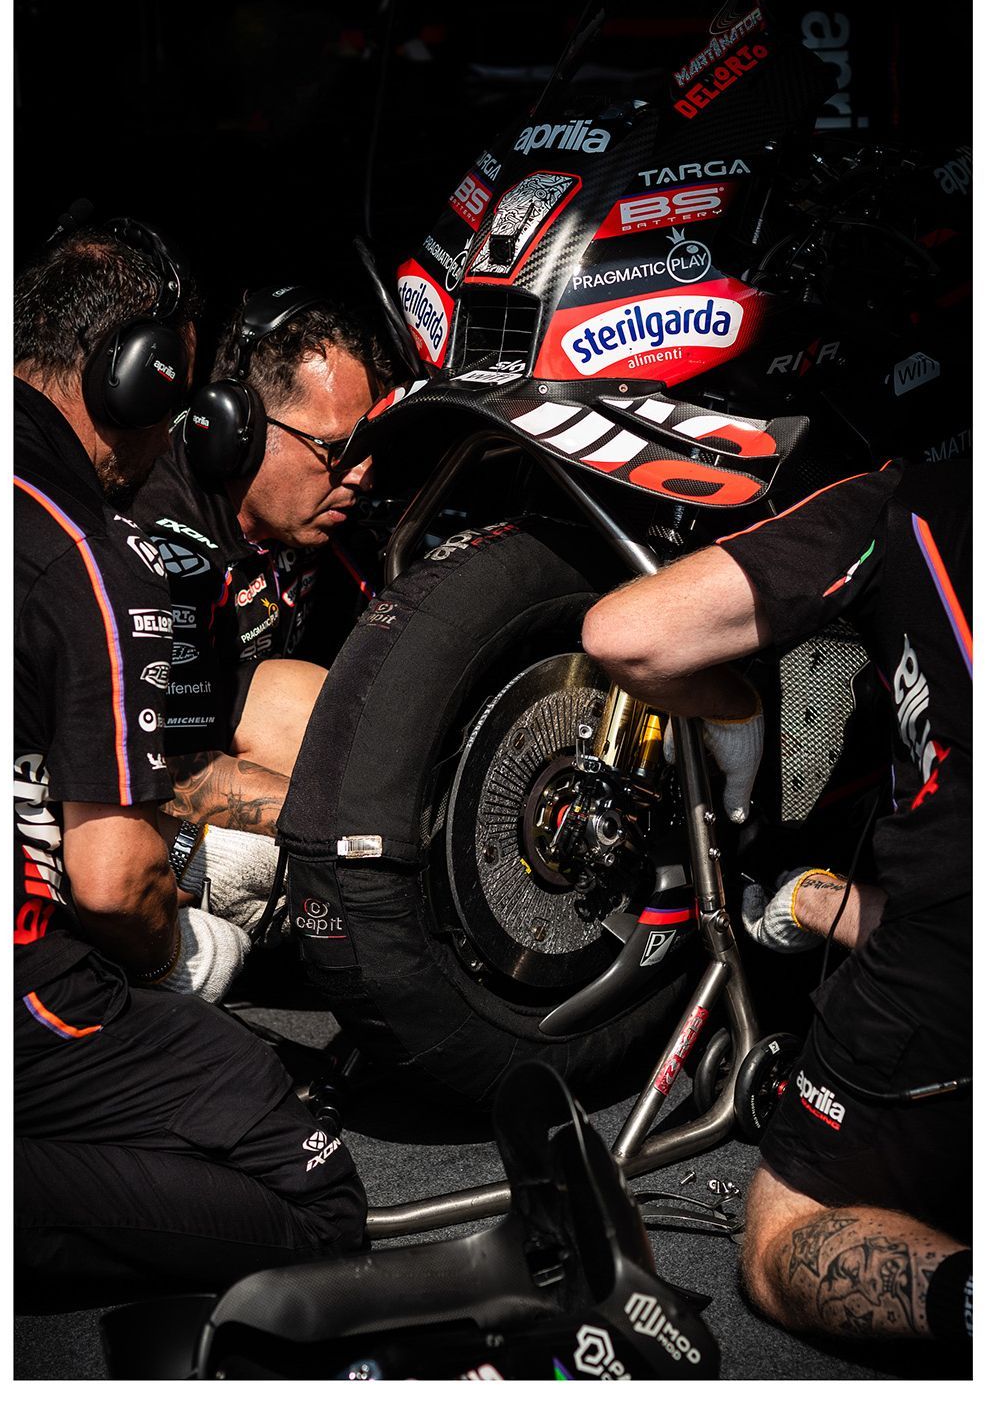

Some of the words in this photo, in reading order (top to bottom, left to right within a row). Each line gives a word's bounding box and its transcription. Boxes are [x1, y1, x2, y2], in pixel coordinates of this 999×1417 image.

[513, 119, 612, 156] aprilia
[638, 158, 751, 187] TARGA
[455, 176, 490, 215] BS
[619, 187, 722, 225] BS
[621, 208, 724, 232] BATTERY
[573, 261, 667, 291] PRAGMATIC
[671, 252, 707, 272] PLAY
[400, 282, 443, 350] terilgarda
[572, 299, 732, 365] sterilgarda
[627, 347, 683, 370] alimenti
[167, 716, 216, 725] MICHELIN
[296, 916, 343, 935] capit
[796, 1069, 847, 1124] aprilia
